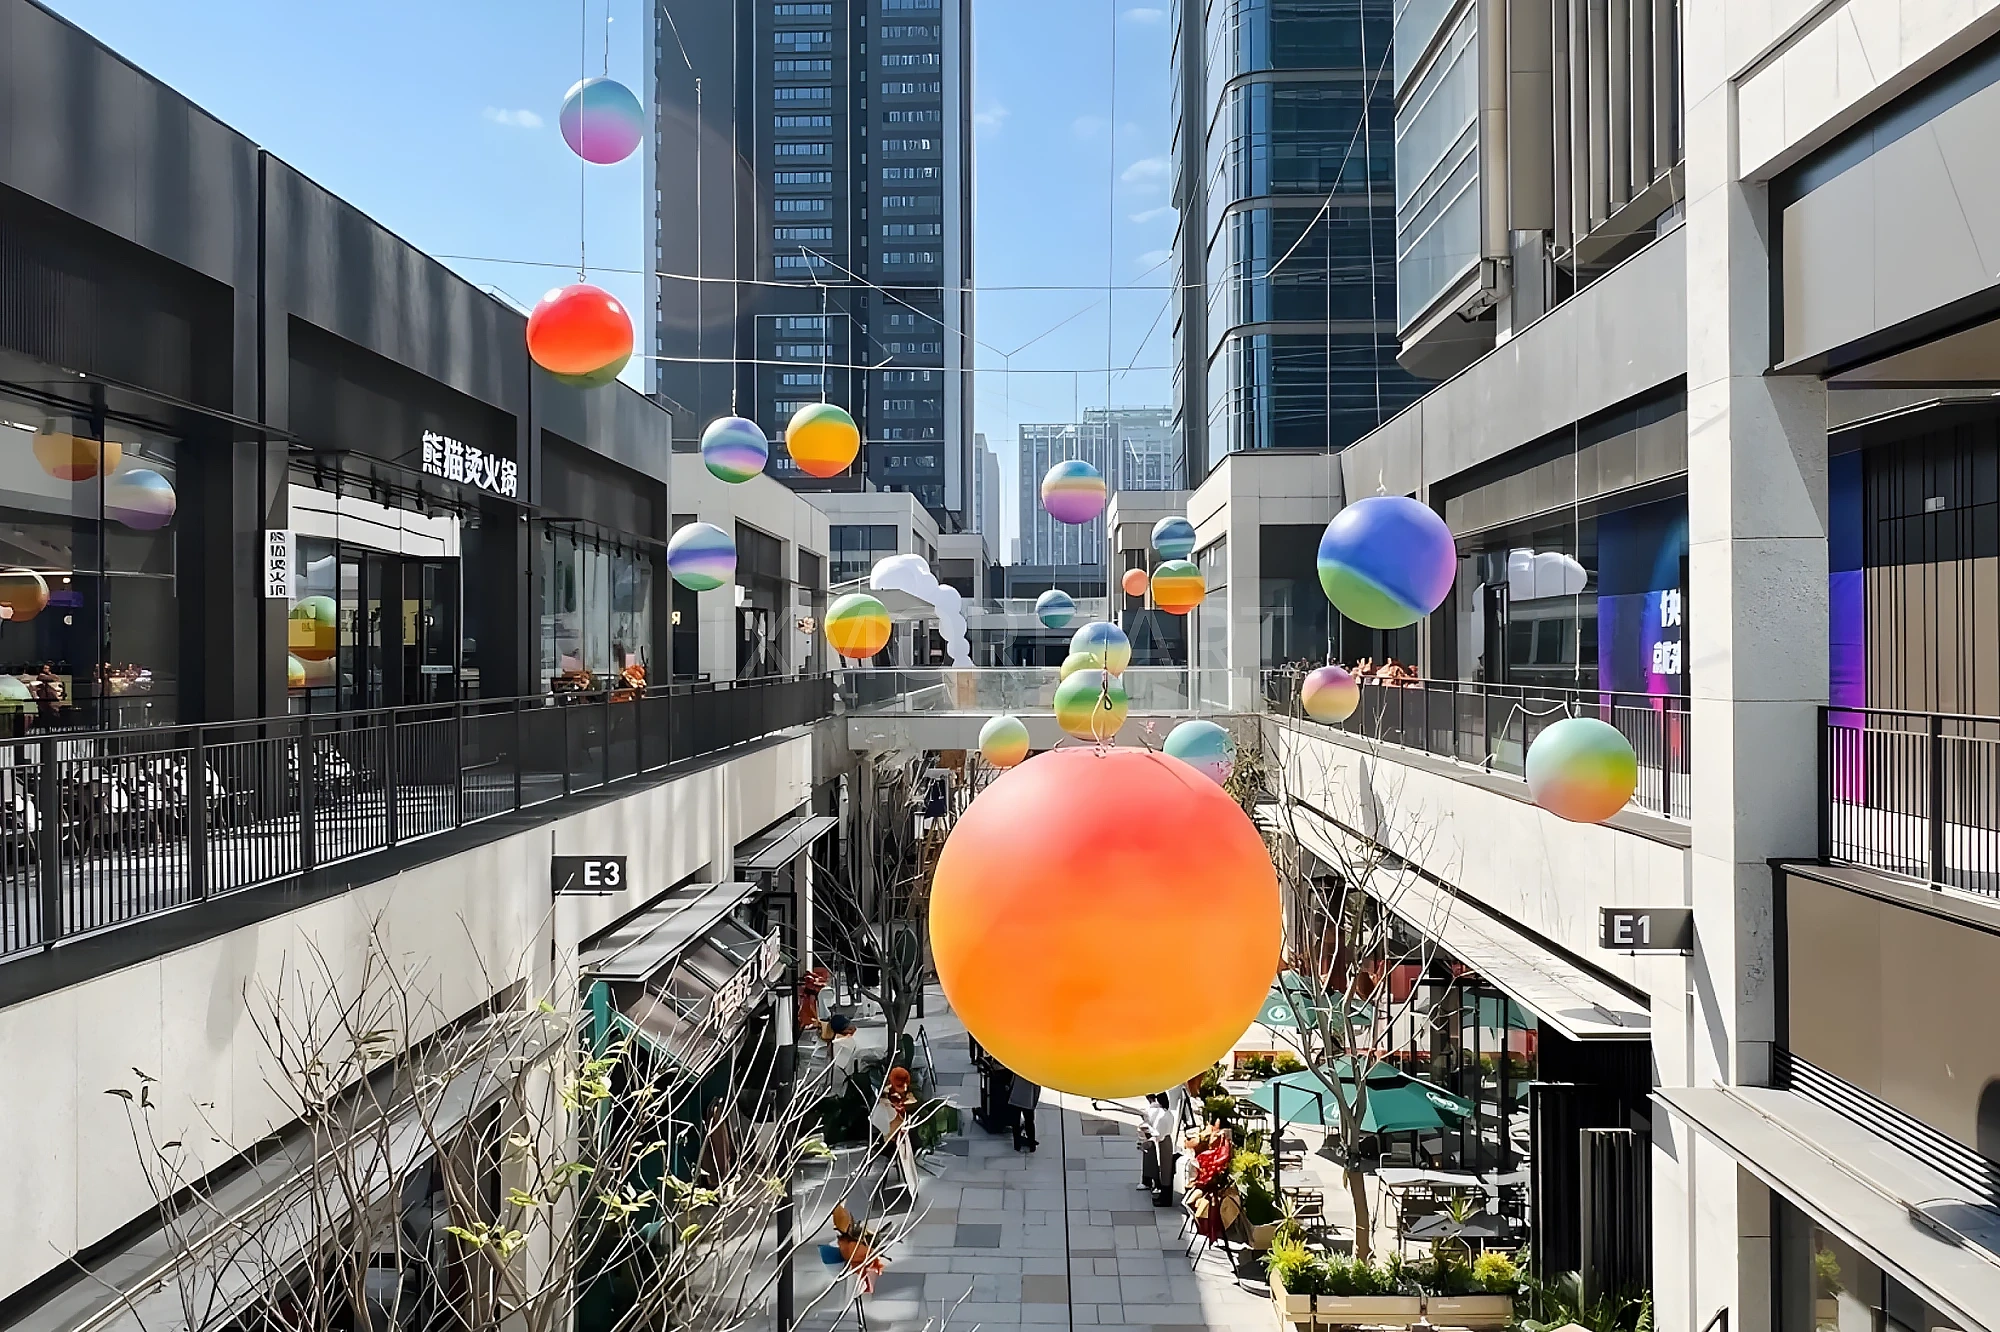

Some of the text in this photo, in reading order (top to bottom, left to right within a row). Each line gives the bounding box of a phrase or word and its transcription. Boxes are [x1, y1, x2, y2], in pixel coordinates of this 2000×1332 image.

[422, 429, 517, 498] 熊猫烫火锅
[584, 861, 620, 886] E3
[1614, 915, 1650, 944] E1
